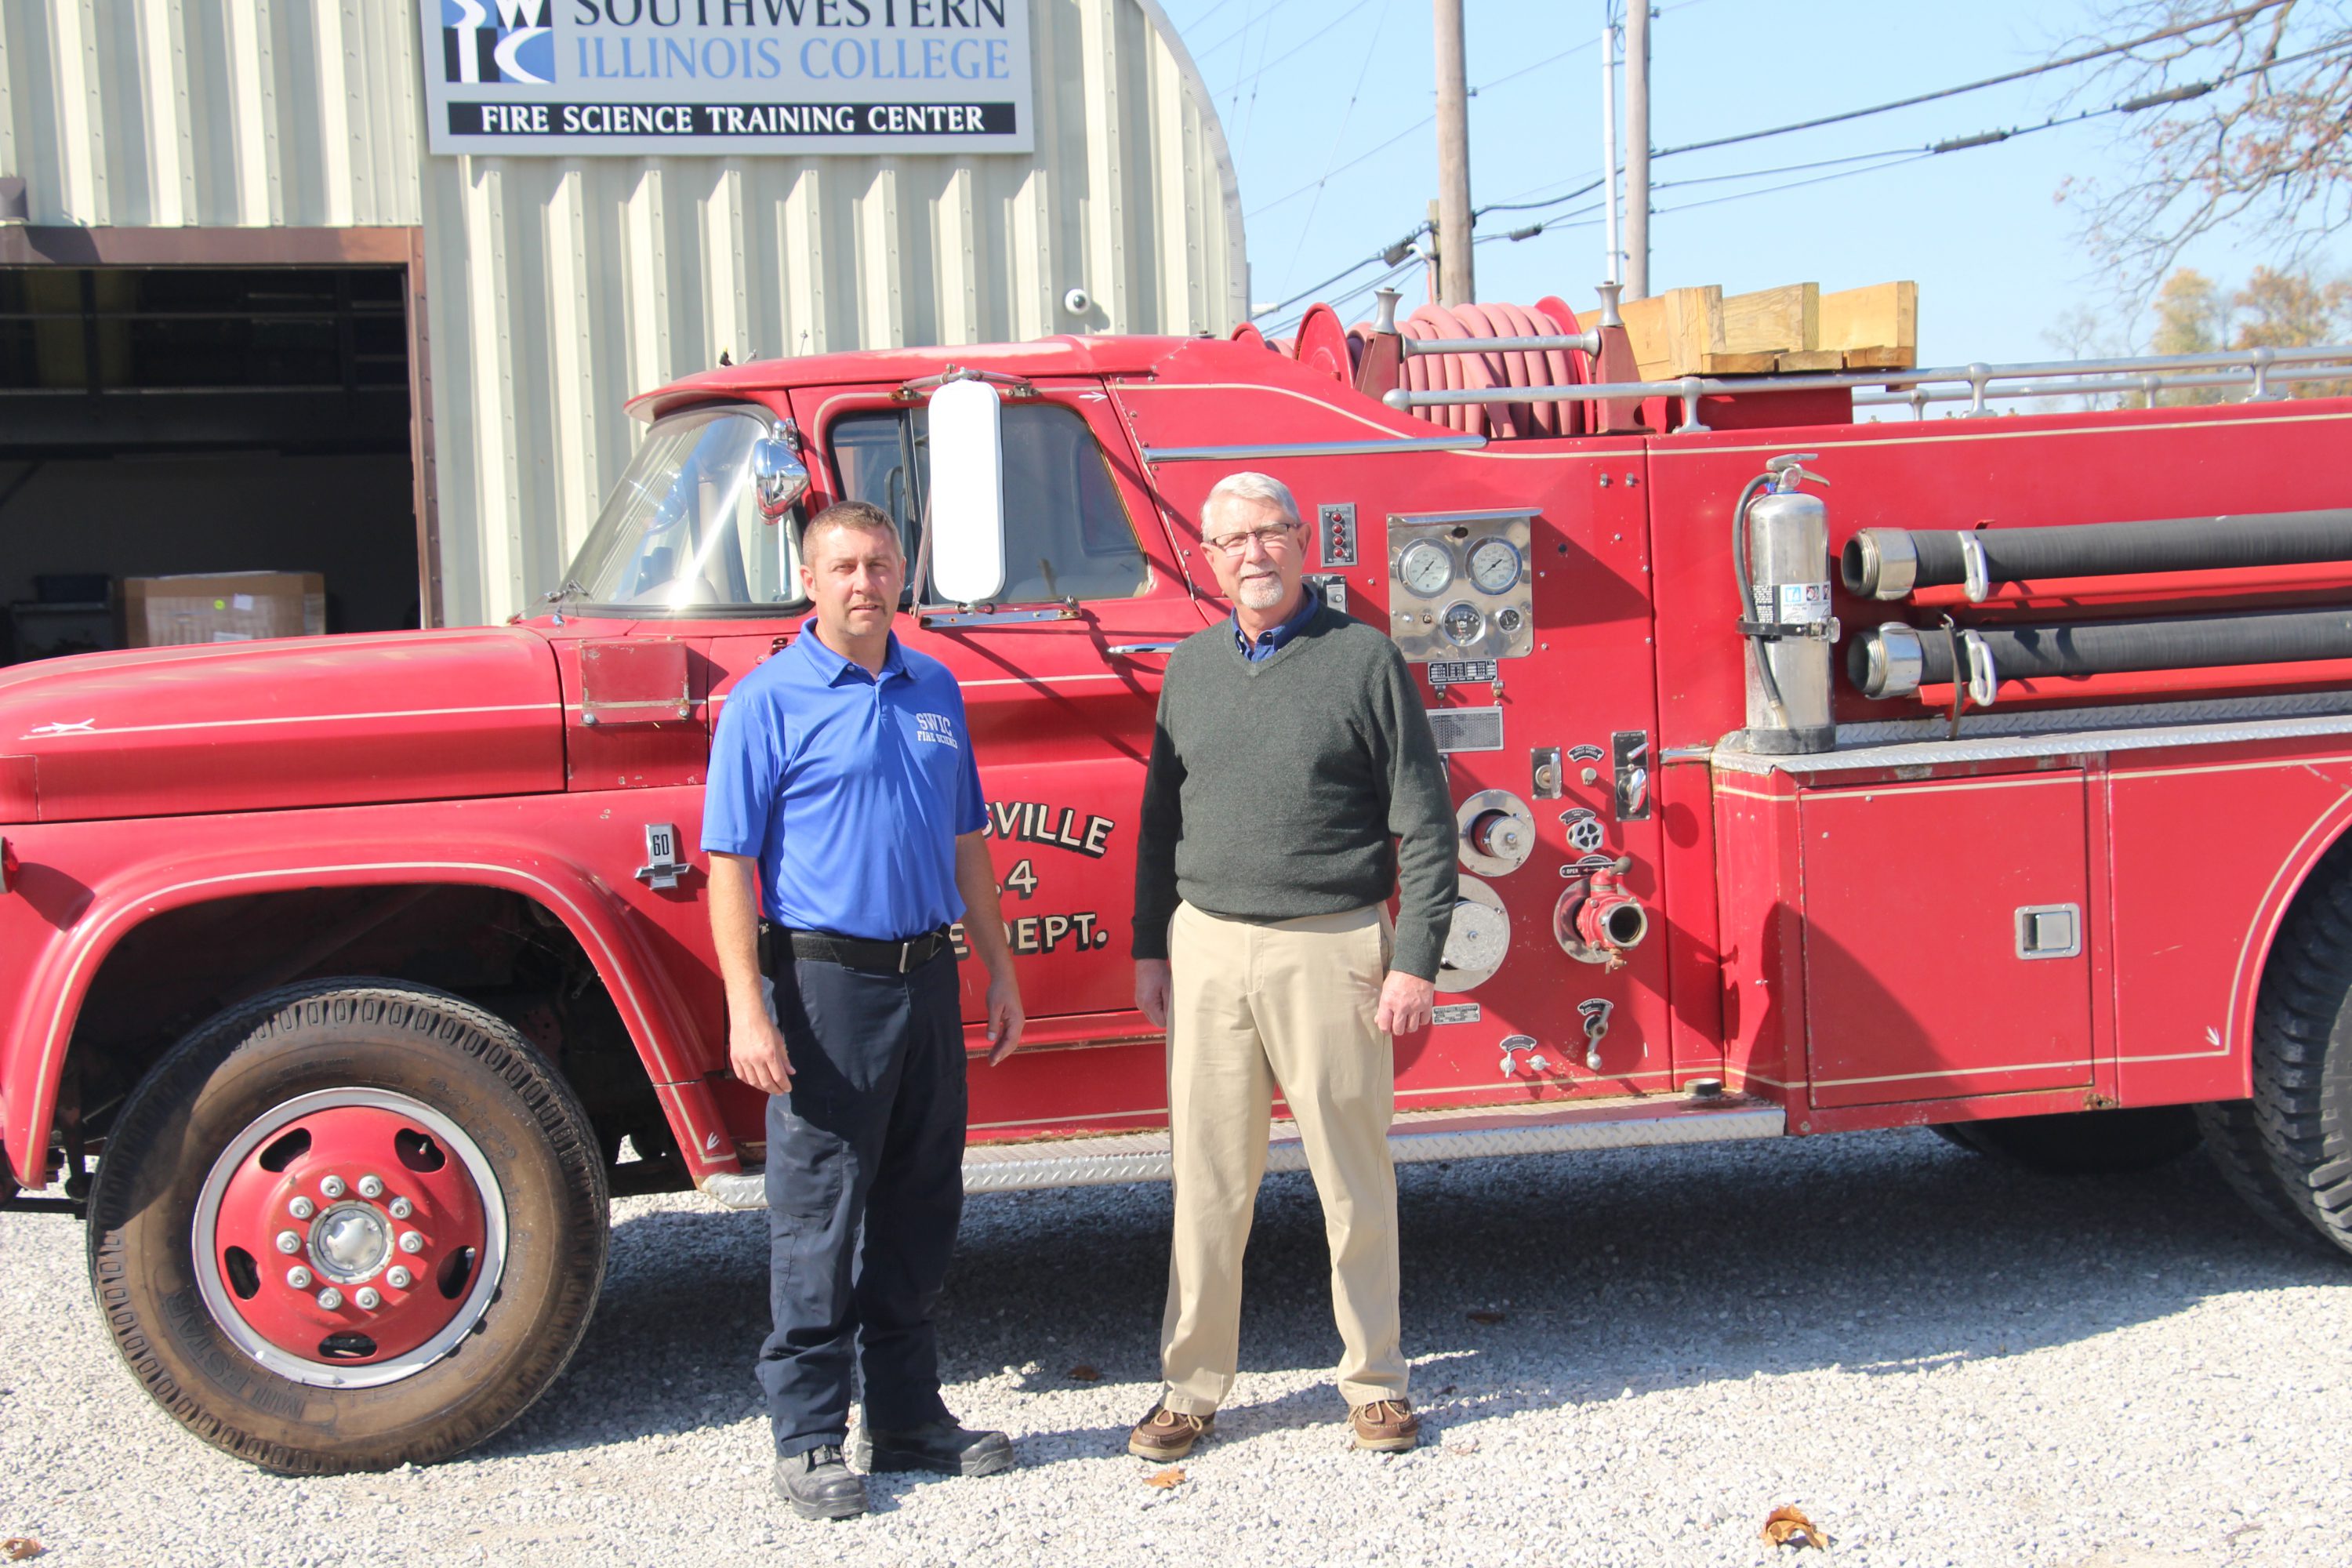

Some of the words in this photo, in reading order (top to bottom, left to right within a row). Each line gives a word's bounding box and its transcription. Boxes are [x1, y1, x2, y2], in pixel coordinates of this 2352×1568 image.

[573, 0, 1006, 28] SOUTHWESTERN
[576, 38, 782, 79] ILLINOIS
[799, 37, 1010, 79] COLLEGE
[481, 105, 549, 133] FIRE
[562, 105, 694, 133] SCIENCE
[705, 105, 855, 132] TRAINING
[866, 104, 985, 132] CENTER
[916, 712, 953, 737] SWIC
[916, 730, 937, 742] FIRE
[652, 833, 670, 856] 60
[166, 1290, 307, 1421] MILESTAR
